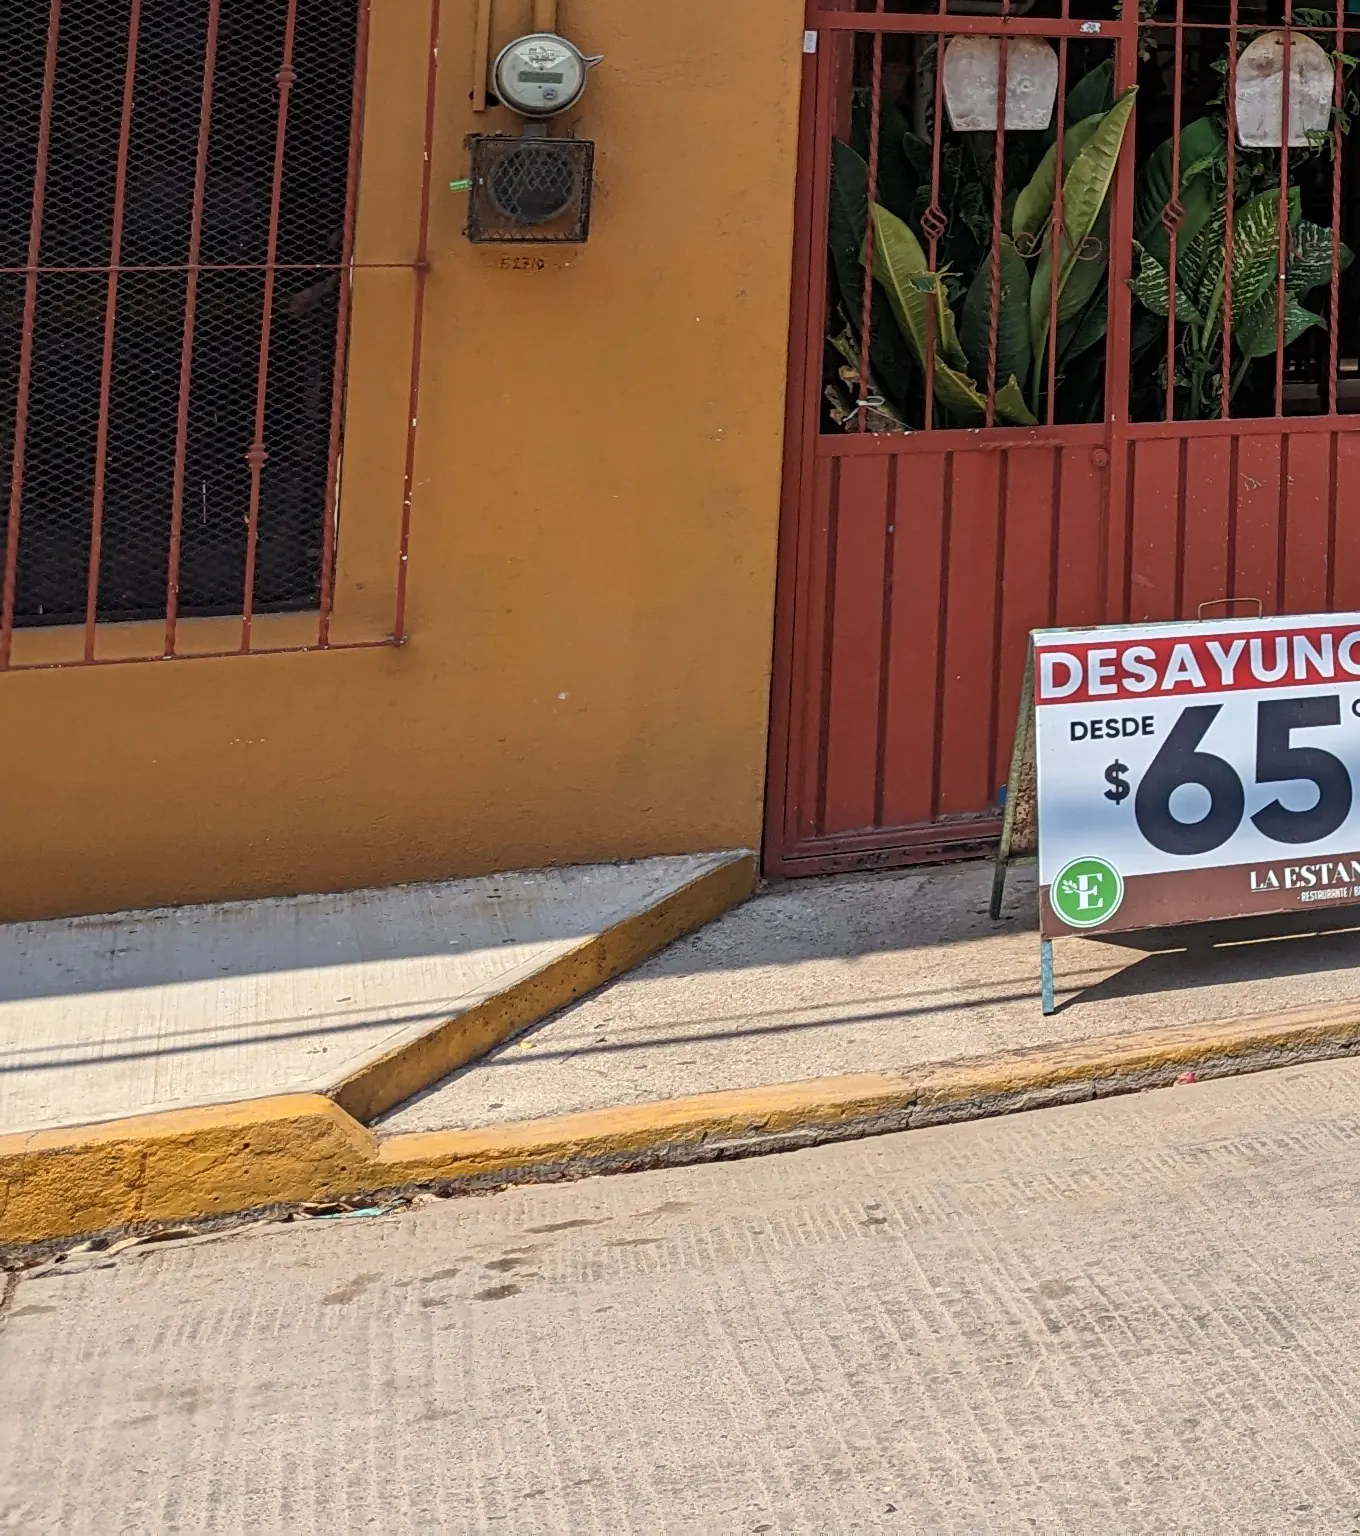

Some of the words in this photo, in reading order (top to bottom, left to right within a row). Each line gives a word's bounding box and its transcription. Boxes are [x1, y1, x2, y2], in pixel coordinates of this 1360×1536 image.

[1070, 715, 1155, 742] DESDE
[1250, 869, 1280, 889] LA
[1301, 886, 1347, 902] RESTAURANTE
